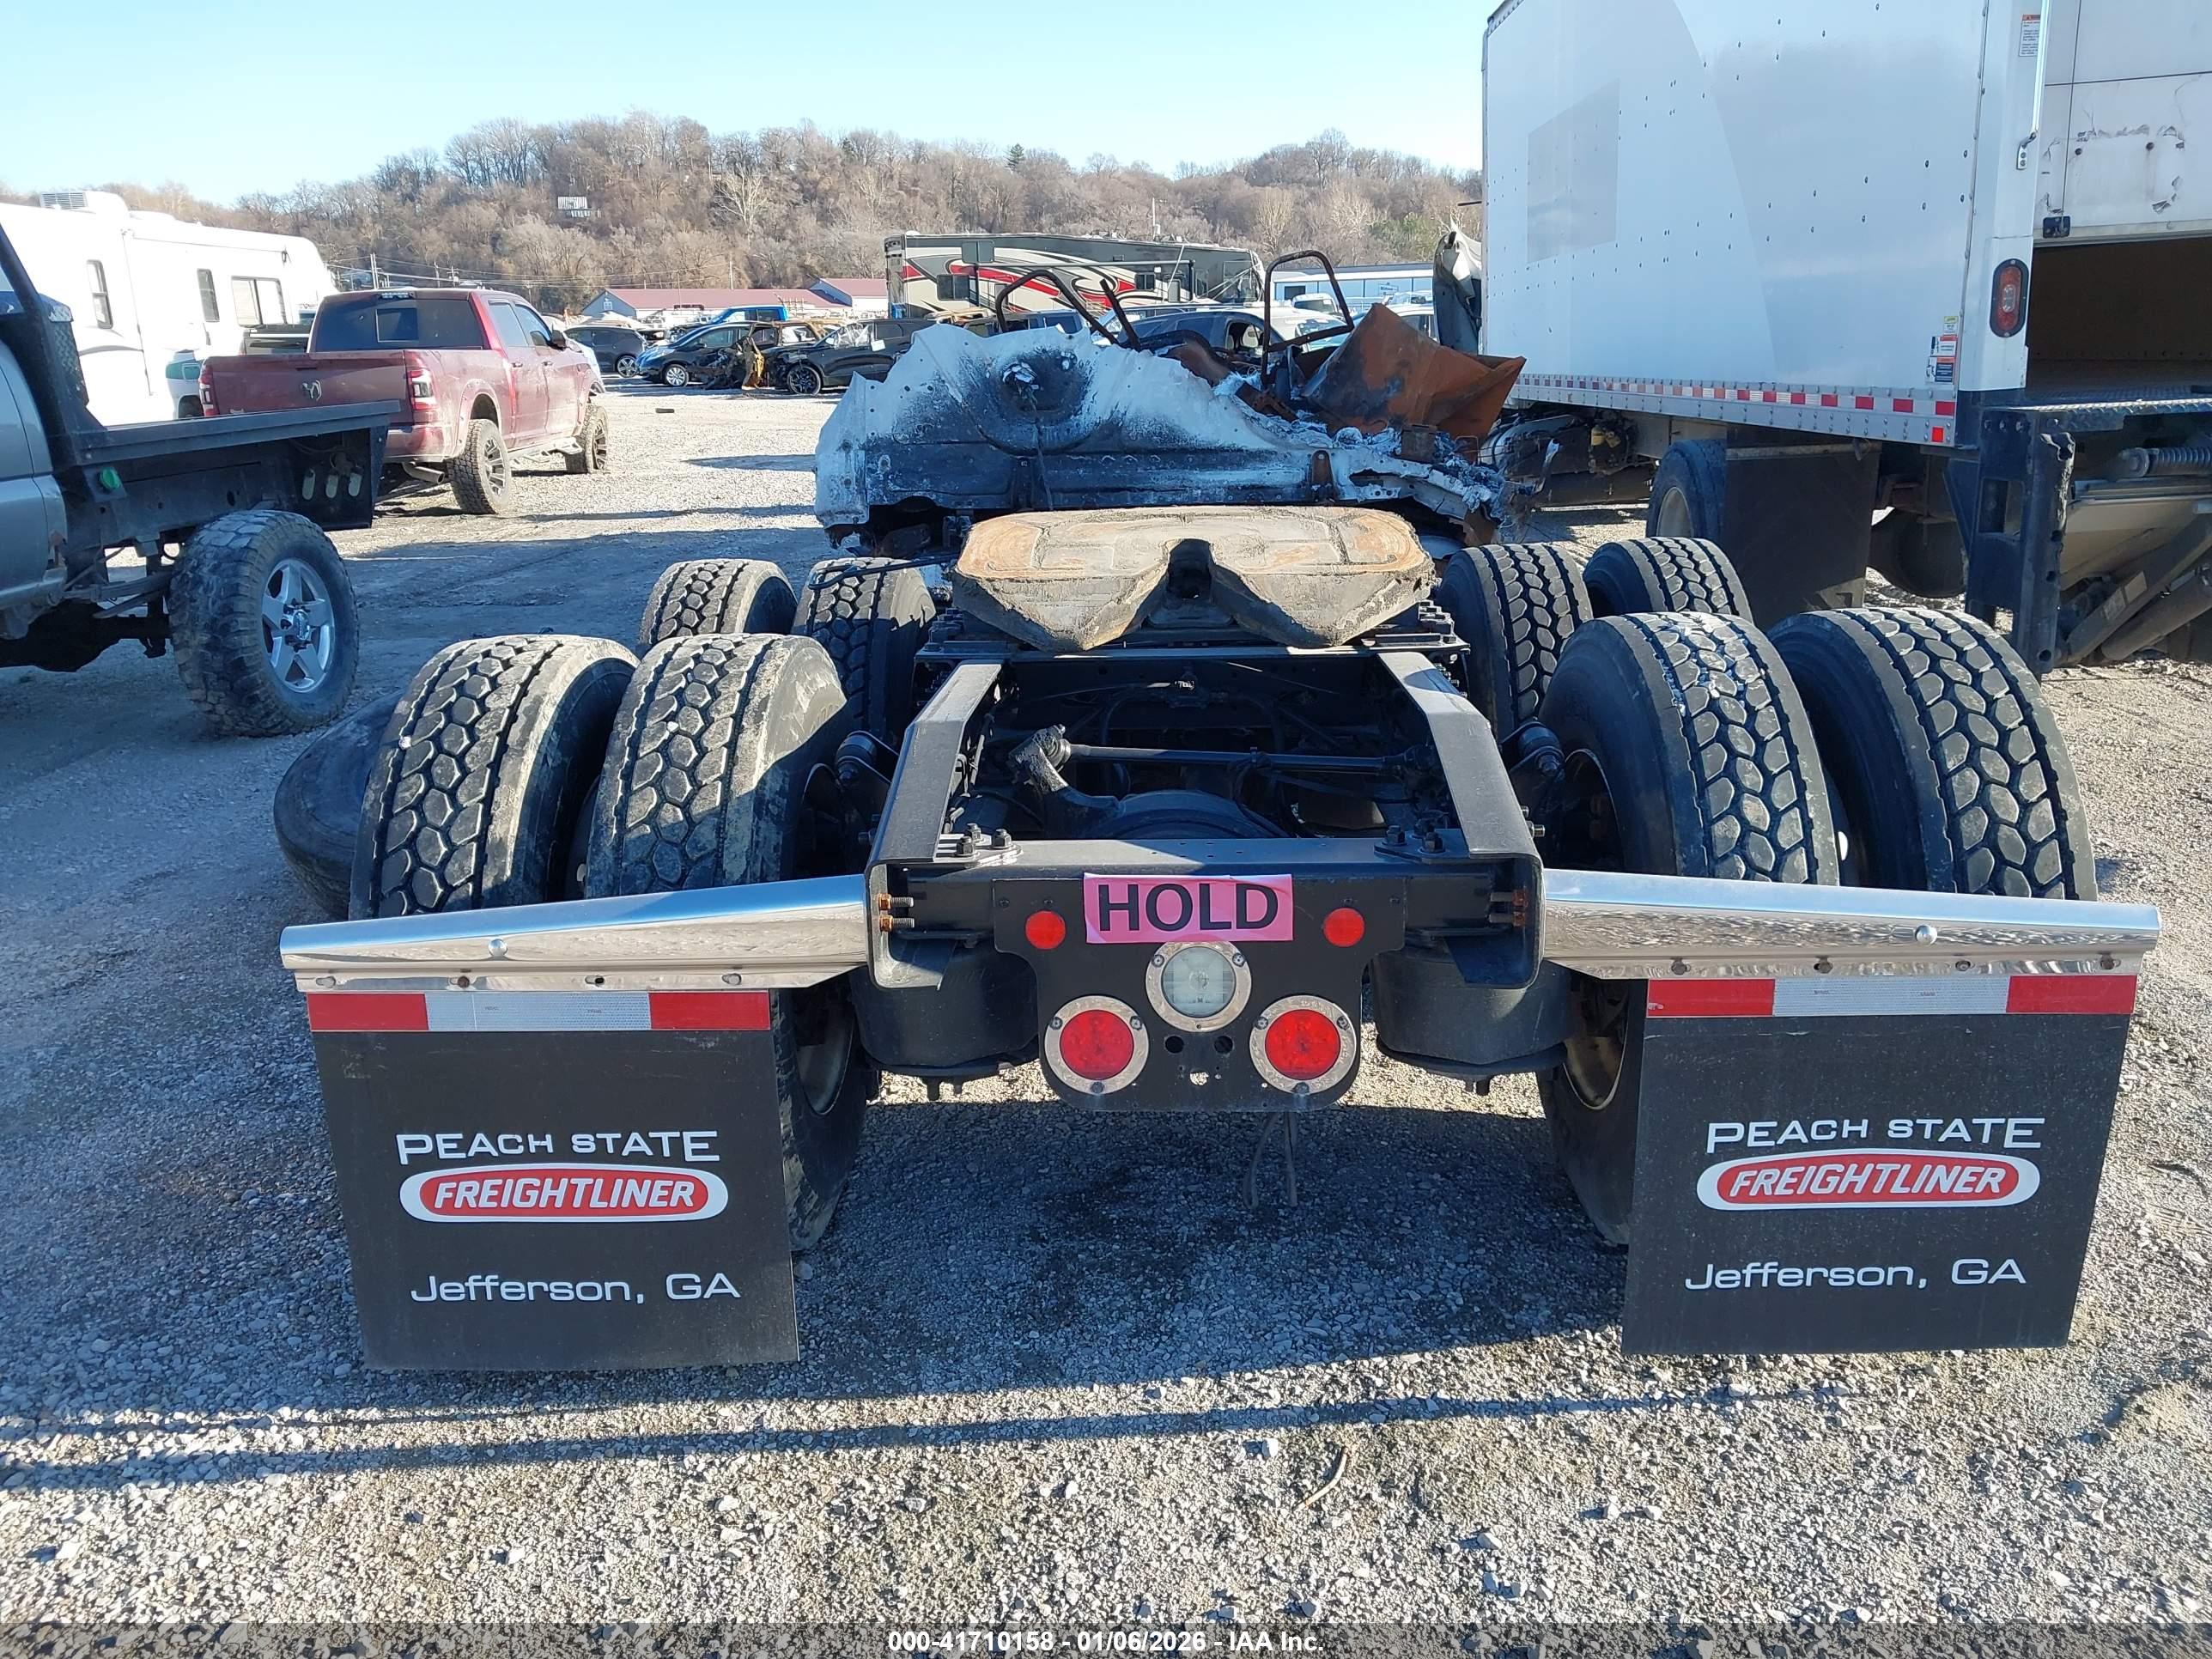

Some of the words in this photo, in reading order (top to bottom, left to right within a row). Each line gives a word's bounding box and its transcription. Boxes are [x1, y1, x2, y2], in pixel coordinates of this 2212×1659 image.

[1098, 883, 1279, 932] HOLD
[396, 1133, 553, 1164] PEACH
[571, 1130, 720, 1162] STATE
[1706, 1119, 1869, 1153] PEACH
[1887, 1117, 2045, 1148] STATE
[433, 1176, 696, 1209] FREIGHTLINER
[1728, 1163, 2007, 1197] FREIGHTLINER
[410, 1274, 644, 1304] Jefferson,
[665, 1273, 741, 1300] GA
[1685, 1262, 1927, 1290] Jefferson,
[1951, 1258, 2027, 1285] GA
